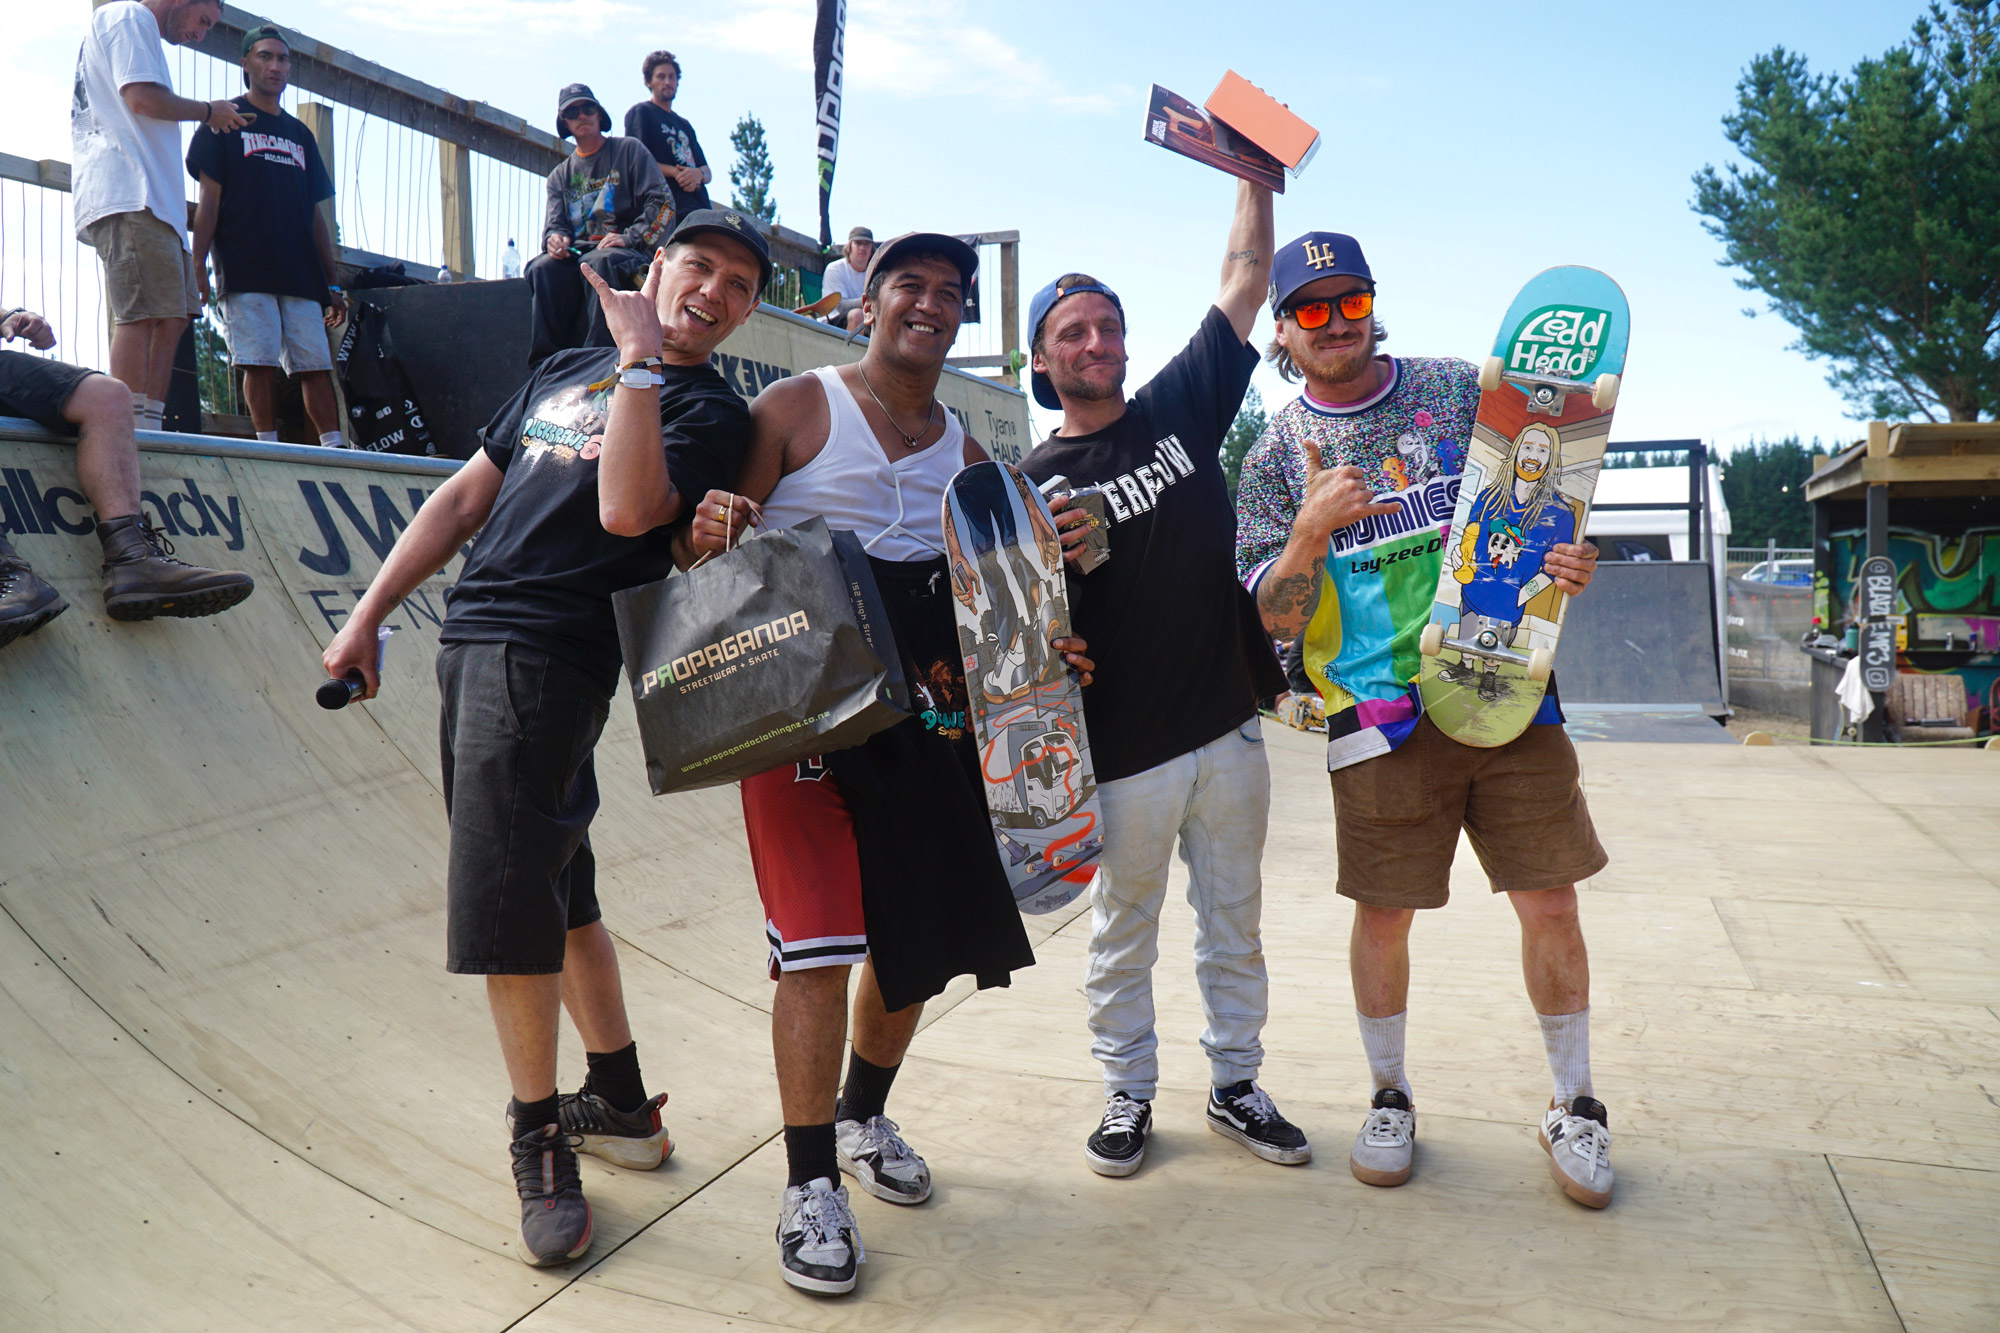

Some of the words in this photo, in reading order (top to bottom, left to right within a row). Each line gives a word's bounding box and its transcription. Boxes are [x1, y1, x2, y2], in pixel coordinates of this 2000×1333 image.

[1518, 309, 1608, 347] Lead
[1510, 342, 1591, 376] Head
[991, 440, 1022, 466] HAUS
[1351, 544, 1425, 575] Lay-zee
[851, 581, 861, 597] 152
[641, 609, 811, 695] PROPAGANDA
[679, 664, 738, 695] STREETWEAR
[748, 648, 780, 666] SKATE
[680, 710, 831, 774] www.propagandaclothingnz.co.nz
